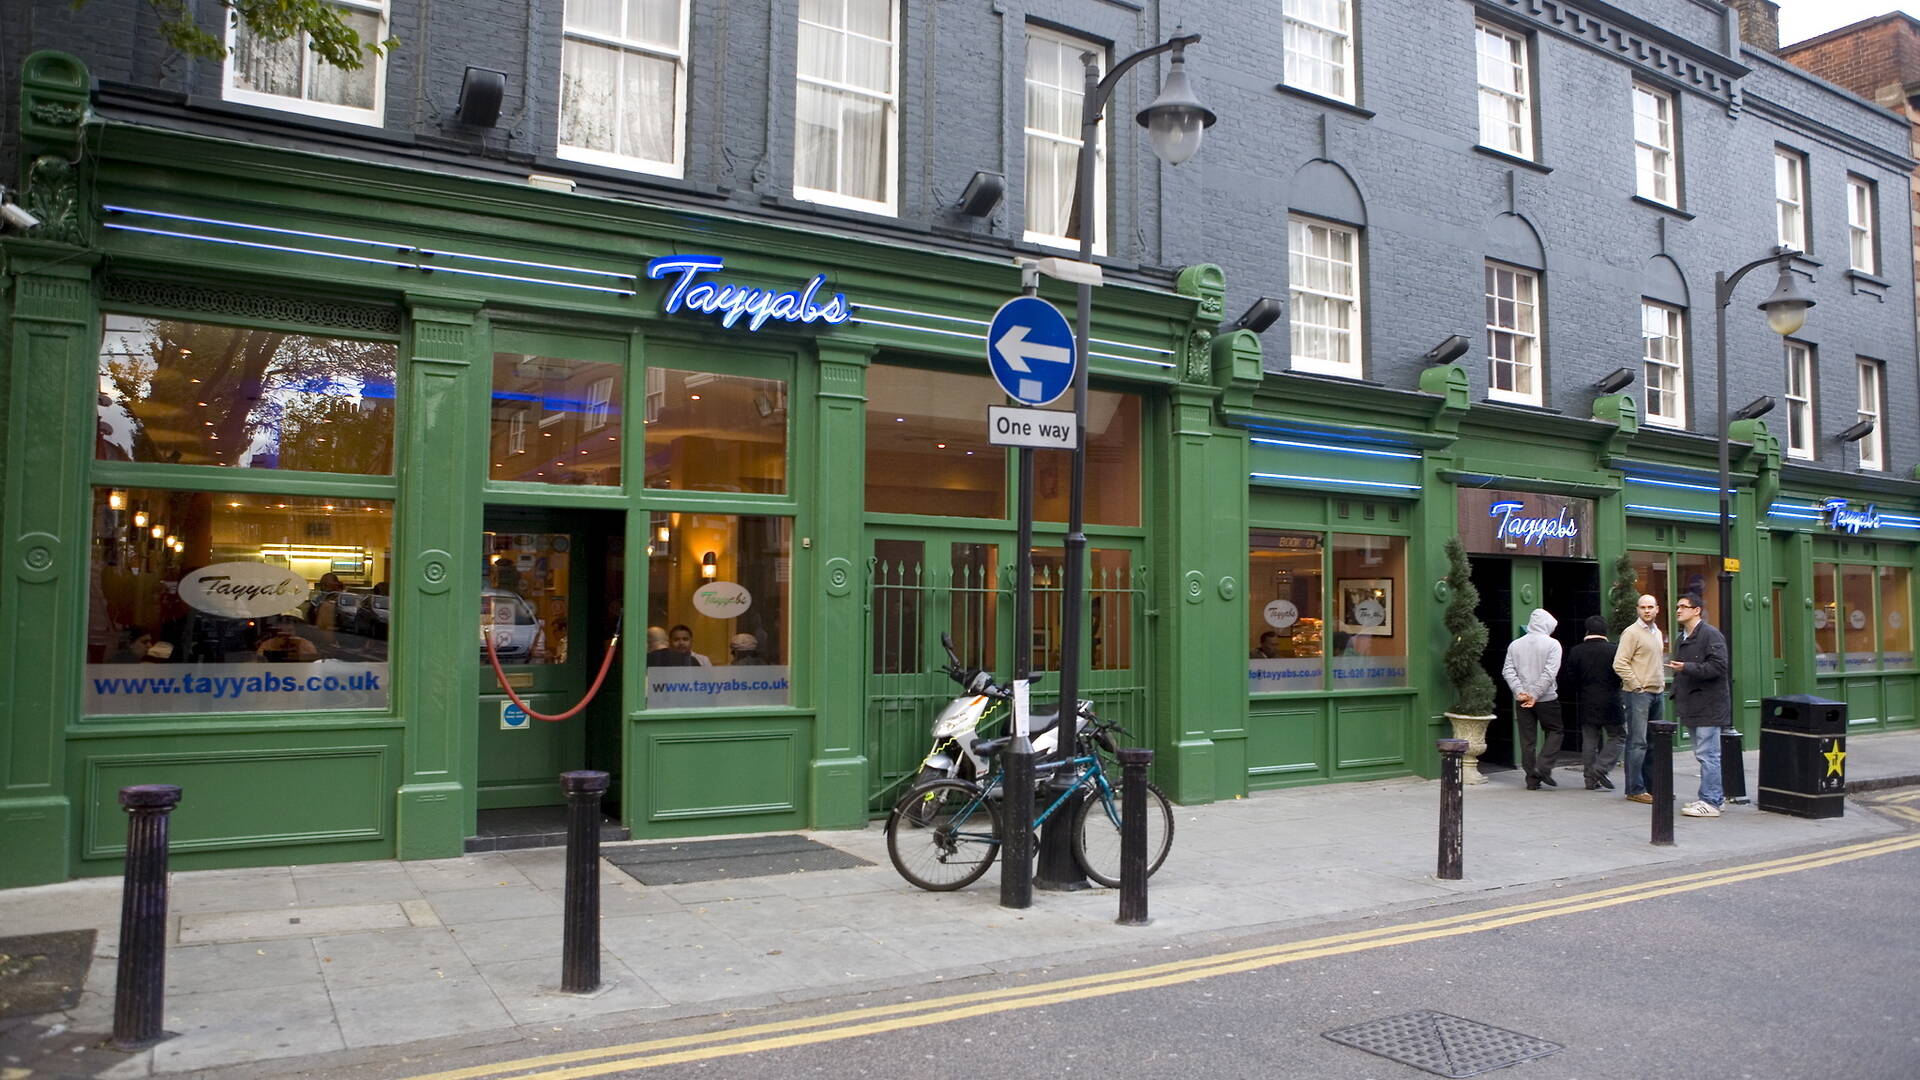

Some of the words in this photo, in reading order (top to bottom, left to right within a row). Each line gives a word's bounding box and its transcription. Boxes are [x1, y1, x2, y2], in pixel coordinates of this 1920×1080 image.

[647, 254, 850, 332] Tayyabs
[996, 416, 1032, 436] One
[1038, 423, 1071, 442] way
[1489, 500, 1578, 547] Tayyabs
[1823, 498, 1881, 534] Tayyabs
[93, 671, 381, 699] www.tayyabs.co.uk
[652, 677, 790, 696] www.tayyabs.co.uk
